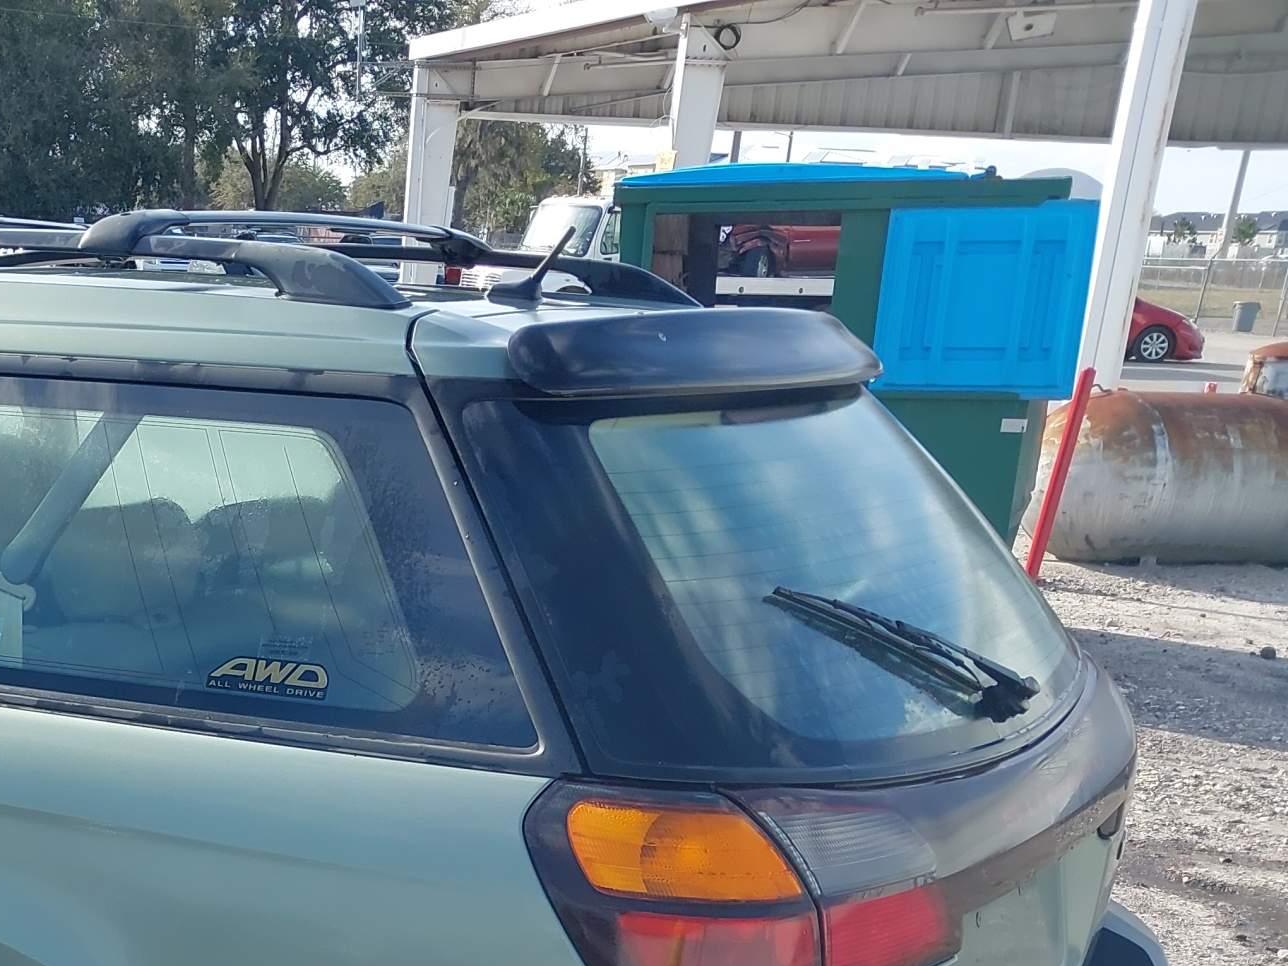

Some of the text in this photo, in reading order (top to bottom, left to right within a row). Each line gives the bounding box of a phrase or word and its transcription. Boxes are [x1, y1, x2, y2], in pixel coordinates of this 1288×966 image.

[209, 657, 328, 689] AWD
[208, 679, 325, 699] ALL WHEEL DRIVE
